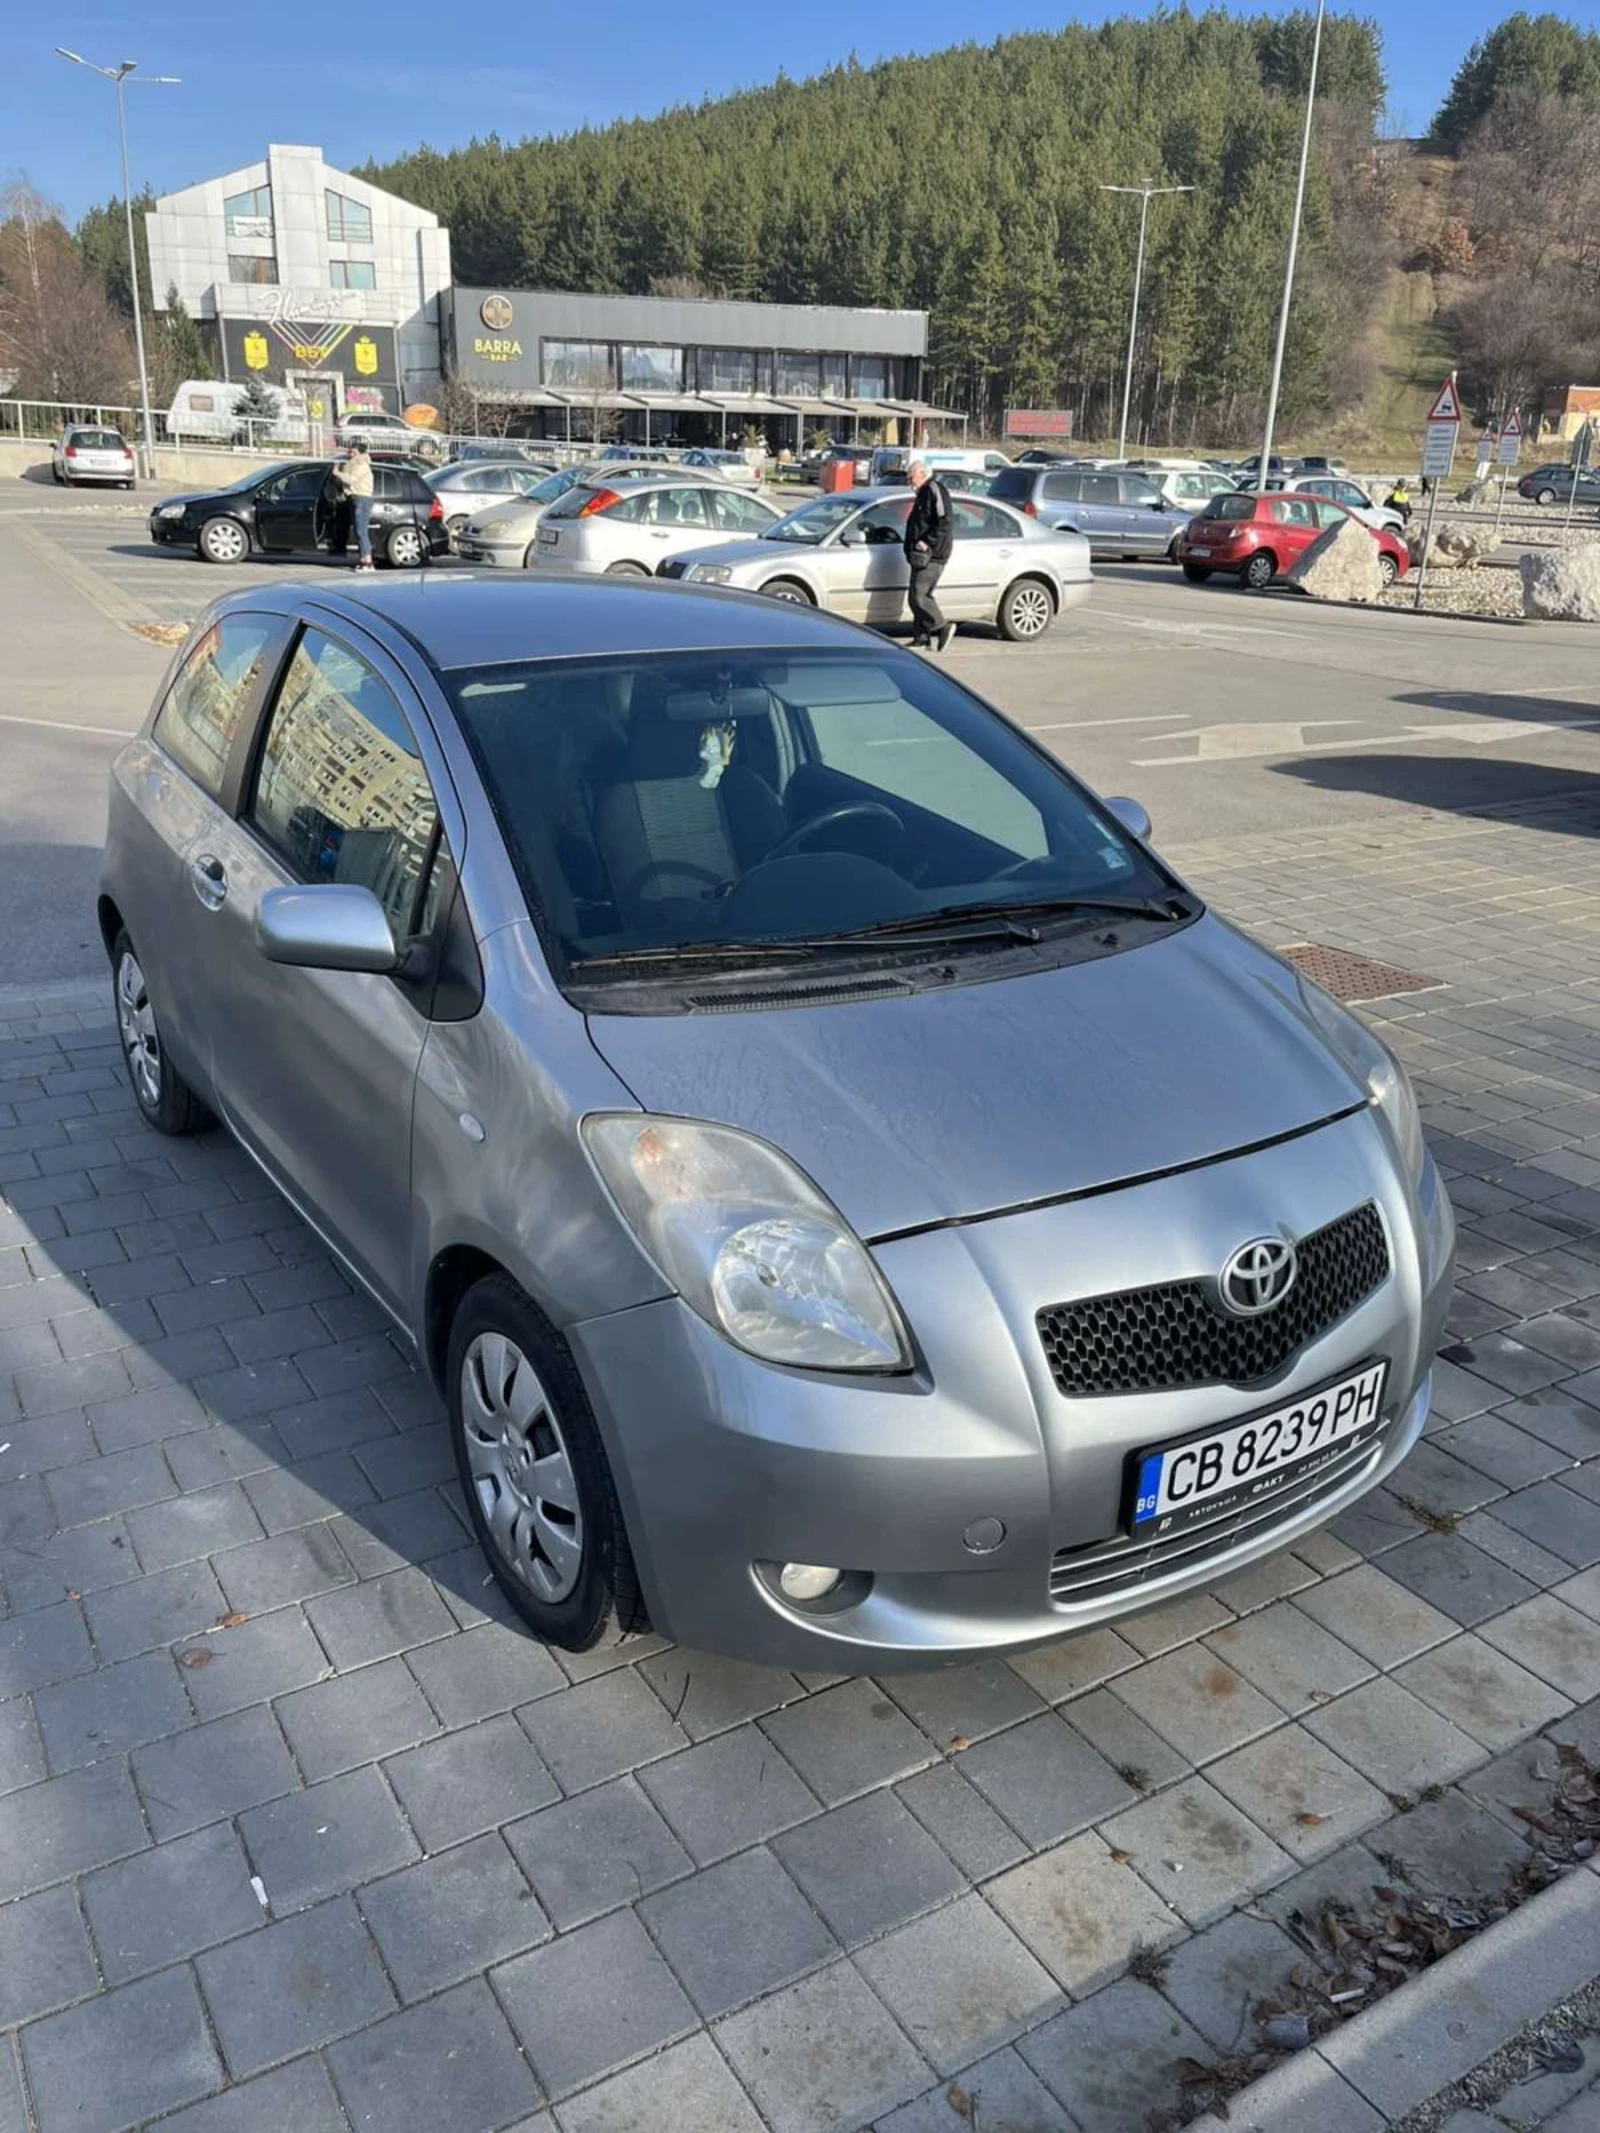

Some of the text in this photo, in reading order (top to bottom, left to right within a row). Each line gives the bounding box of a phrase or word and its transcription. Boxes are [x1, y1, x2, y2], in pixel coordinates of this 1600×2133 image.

[474, 338, 522, 355] BARRA
[1167, 1371, 1381, 1502] CB 8239 PH
[1135, 1494, 1156, 1514] BG
